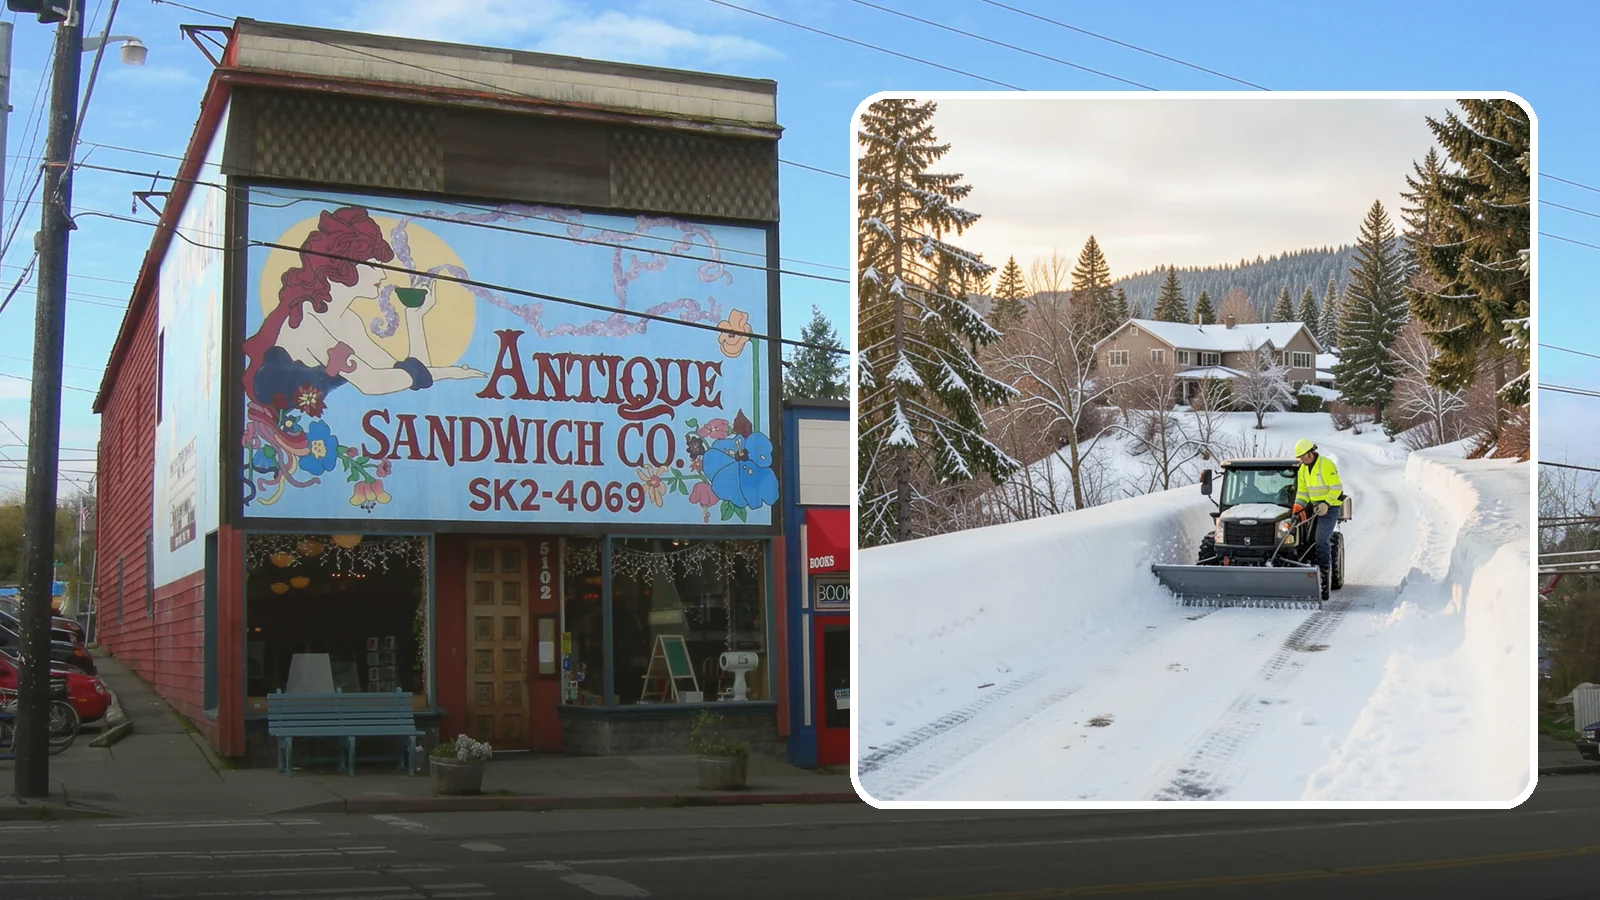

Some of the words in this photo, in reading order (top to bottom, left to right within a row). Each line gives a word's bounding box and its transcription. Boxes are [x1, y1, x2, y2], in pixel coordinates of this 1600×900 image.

[476, 329, 723, 420] ANTIQUE
[361, 409, 604, 467] SANDWICH
[617, 422, 685, 469] CO.
[468, 477, 646, 512] SK2-4069
[540, 541, 551, 600] 5102
[809, 555, 835, 569] BOOKS
